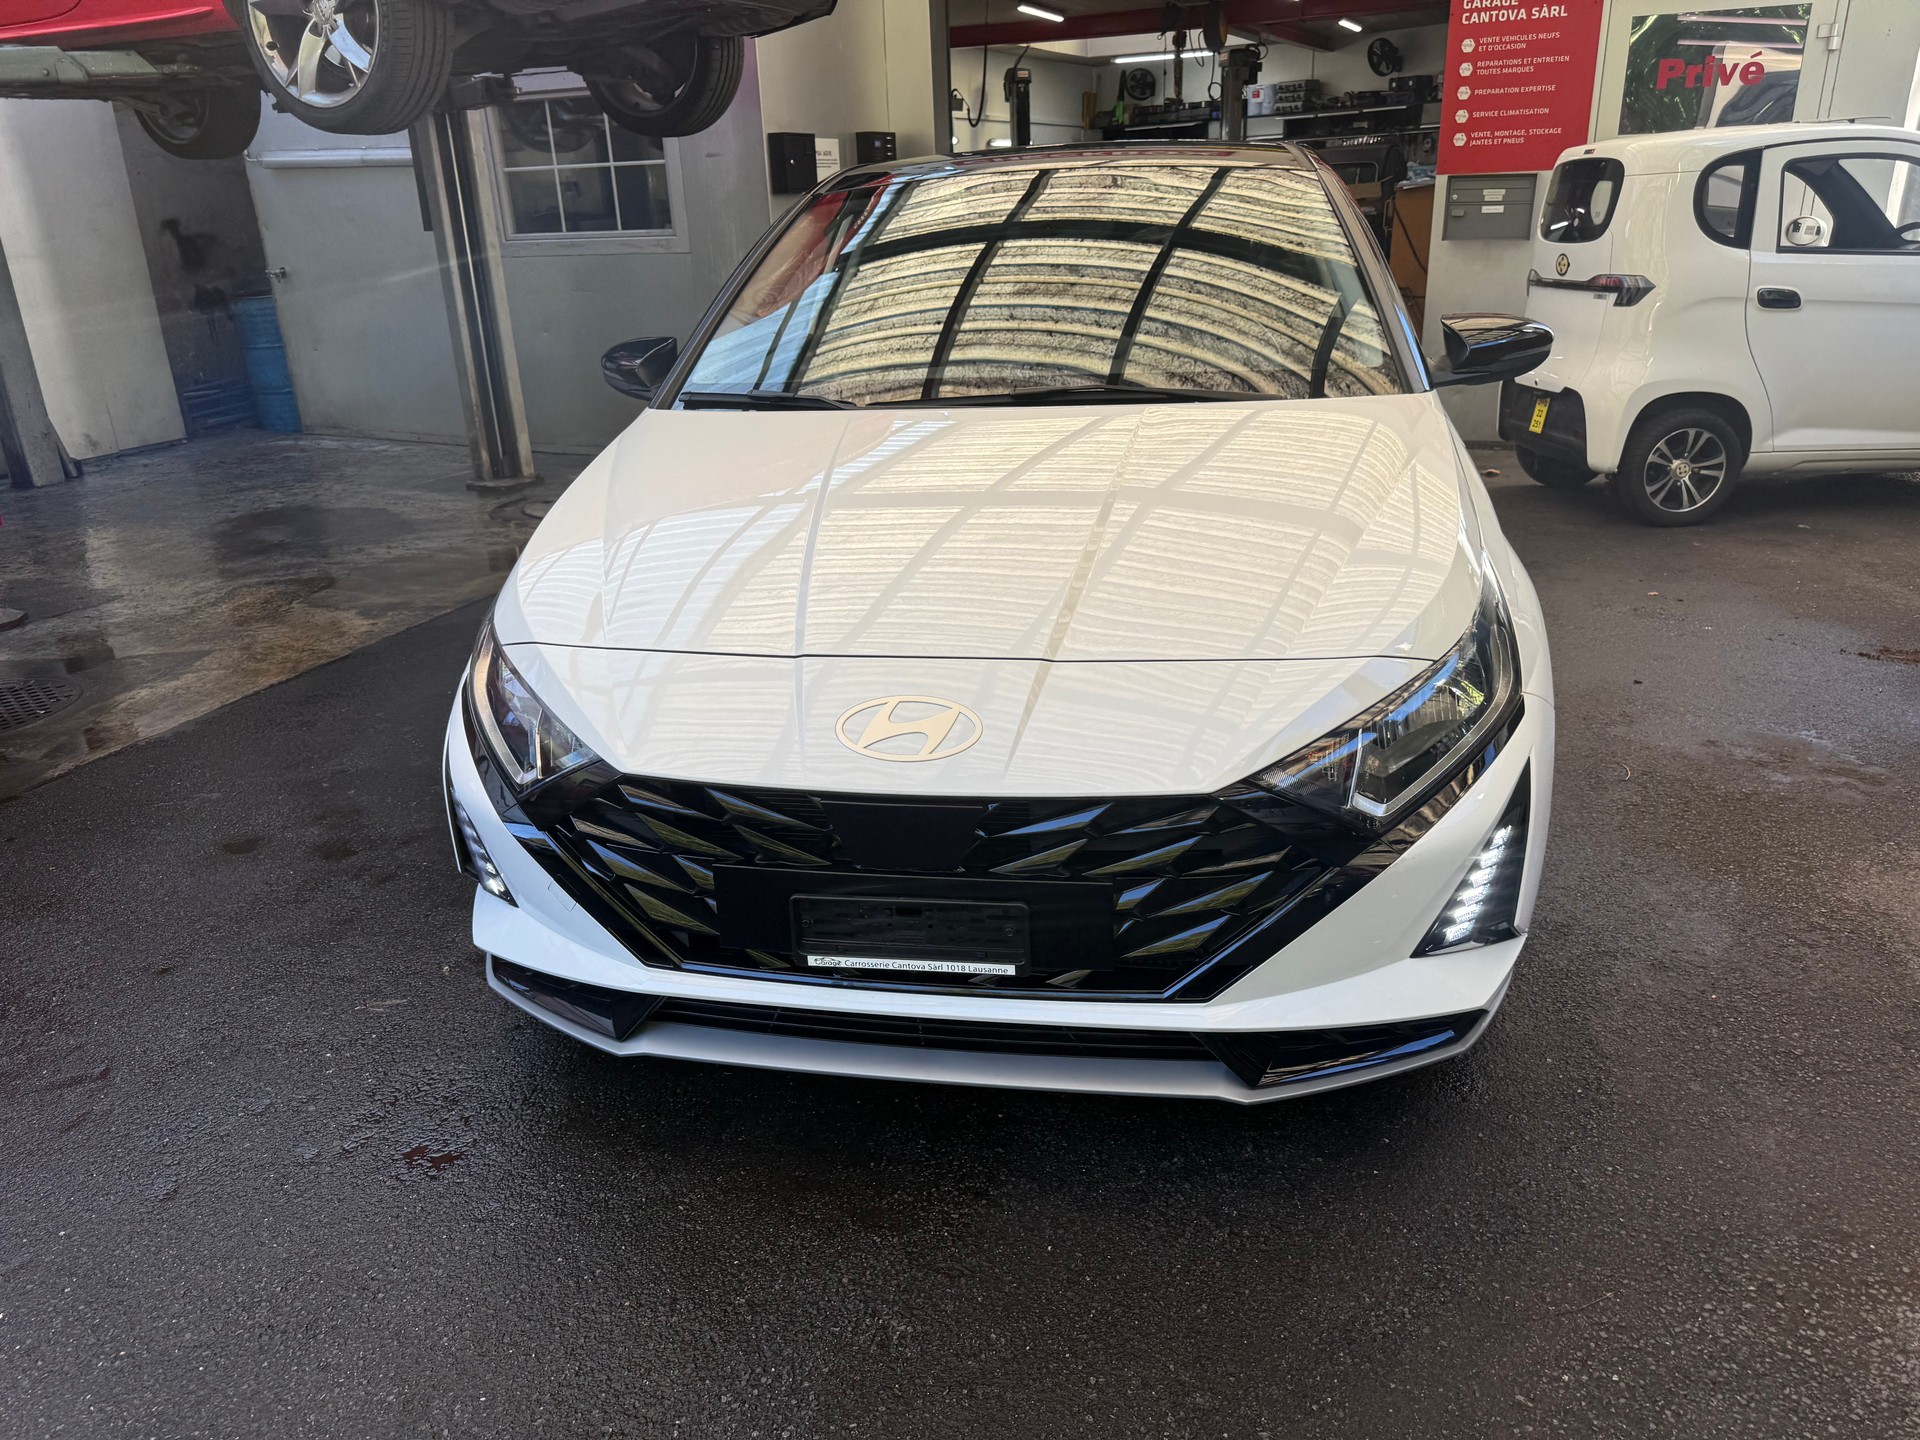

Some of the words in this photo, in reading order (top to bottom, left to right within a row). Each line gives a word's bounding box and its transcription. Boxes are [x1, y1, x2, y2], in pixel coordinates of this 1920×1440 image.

[1462, 8, 1527, 25] CANTOVA
[1531, 4, 1568, 19] SÀRL
[1479, 36, 1500, 44] VENTE
[1501, 33, 1537, 42] VEHICULES
[1538, 31, 1560, 40] NEUFS
[1488, 43, 1526, 51] D'OCCASION
[1477, 58, 1522, 67] REPARATIONS
[1533, 55, 1570, 64] ENTRETIEN
[1477, 67, 1501, 75] TOUTES
[1502, 66, 1534, 75] MARQUES
[1656, 51, 1765, 90] Privé
[1475, 87, 1520, 96] PREPARATION
[1521, 84, 1556, 93] EXPERTISE
[1472, 110, 1499, 118] SERVICE
[1500, 107, 1550, 117] CLIMATISATION
[1470, 130, 1493, 138] VENTE,
[1529, 127, 1562, 135] STOCKAGE
[1469, 138, 1493, 147] JANTES
[1494, 137, 1502, 145] ET
[844, 959, 890, 969] Carrosserie
[891, 961, 926, 970] Cantova
[946, 964, 966, 972] 1018
[968, 965, 1009, 975] Lausanne
